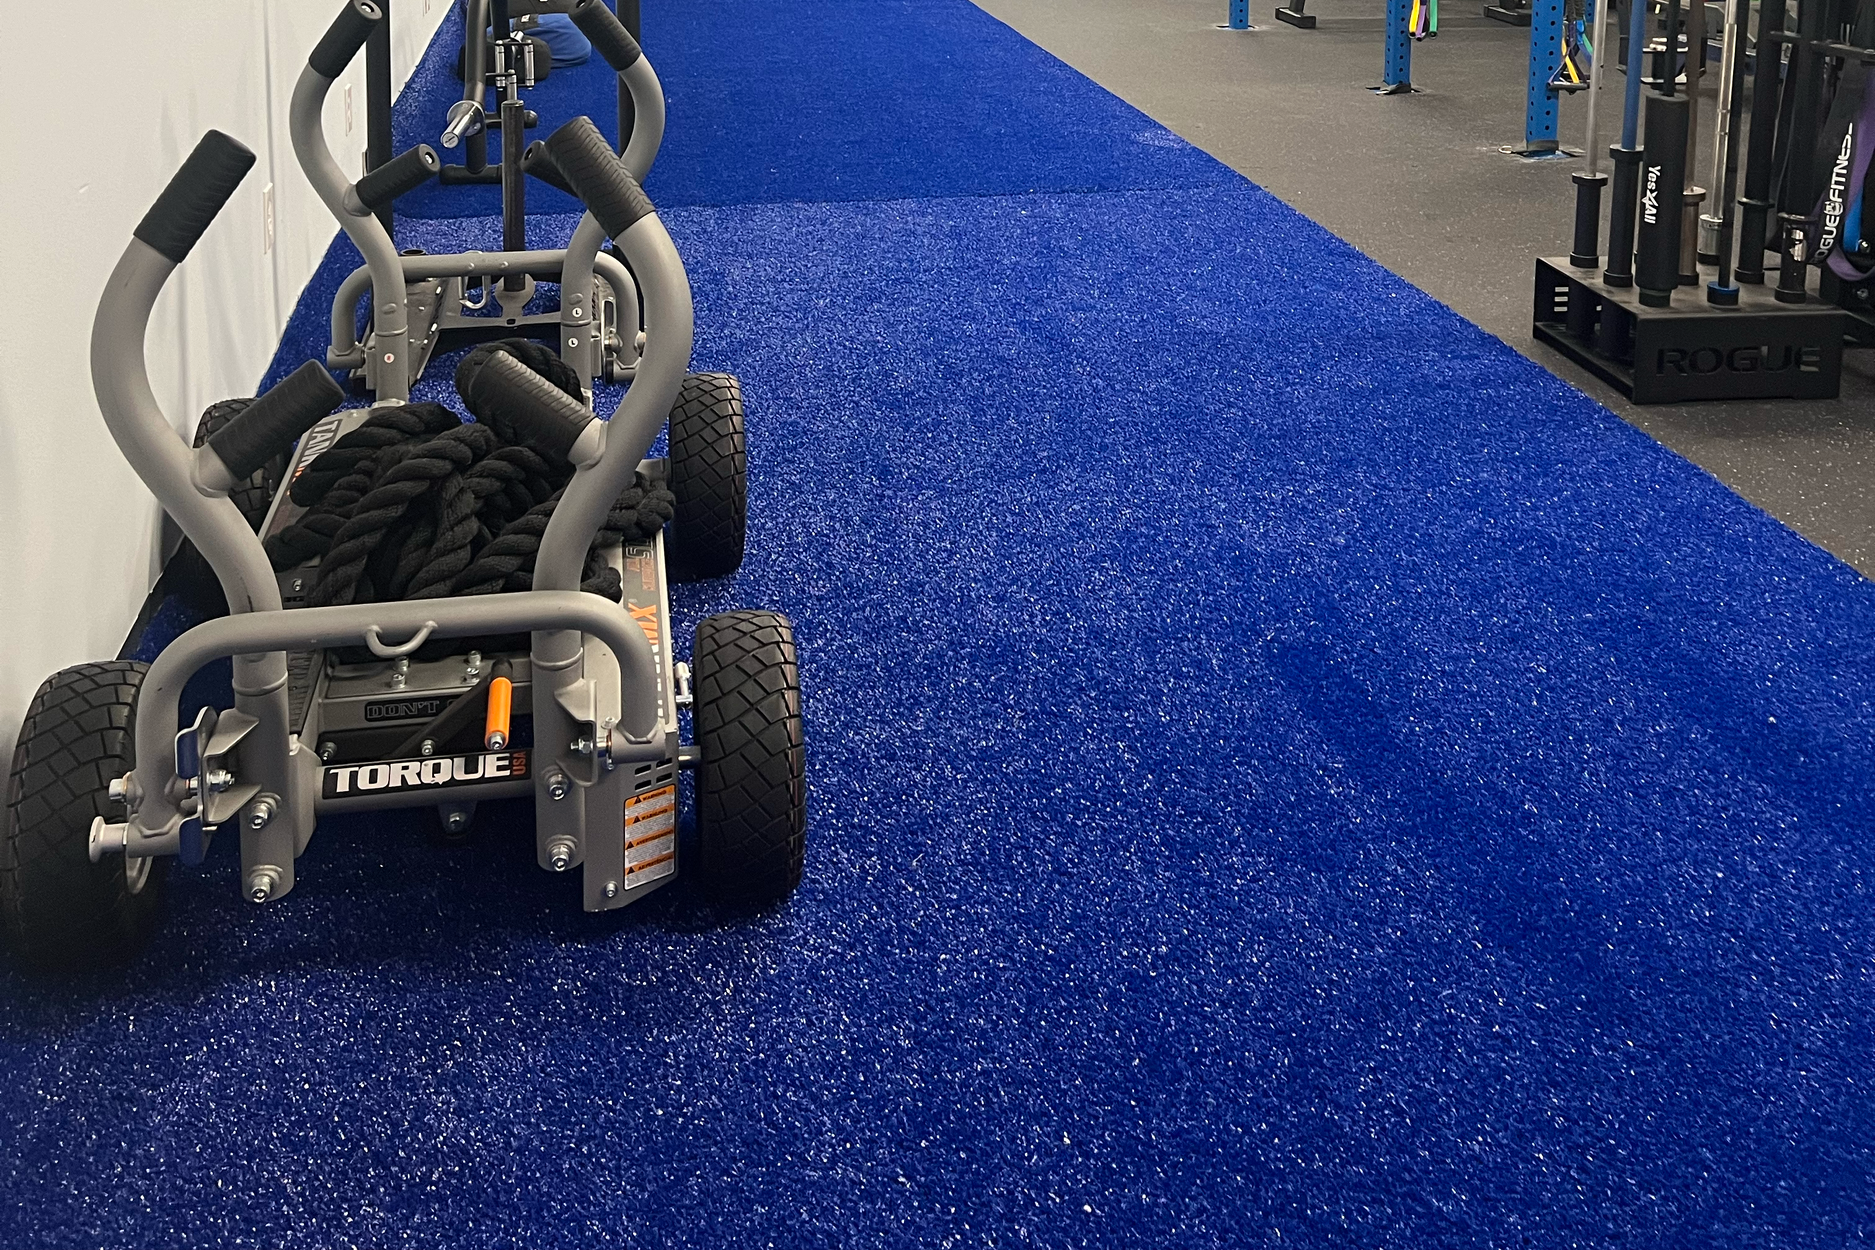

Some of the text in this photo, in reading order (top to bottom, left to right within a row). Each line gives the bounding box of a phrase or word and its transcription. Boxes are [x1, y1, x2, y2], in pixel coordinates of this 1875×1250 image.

[1641, 165, 1661, 224] Yes4All
[1655, 345, 1821, 377] ROGUE
[366, 700, 440, 719] DON'T
[329, 751, 526, 792] TORQUE USA
